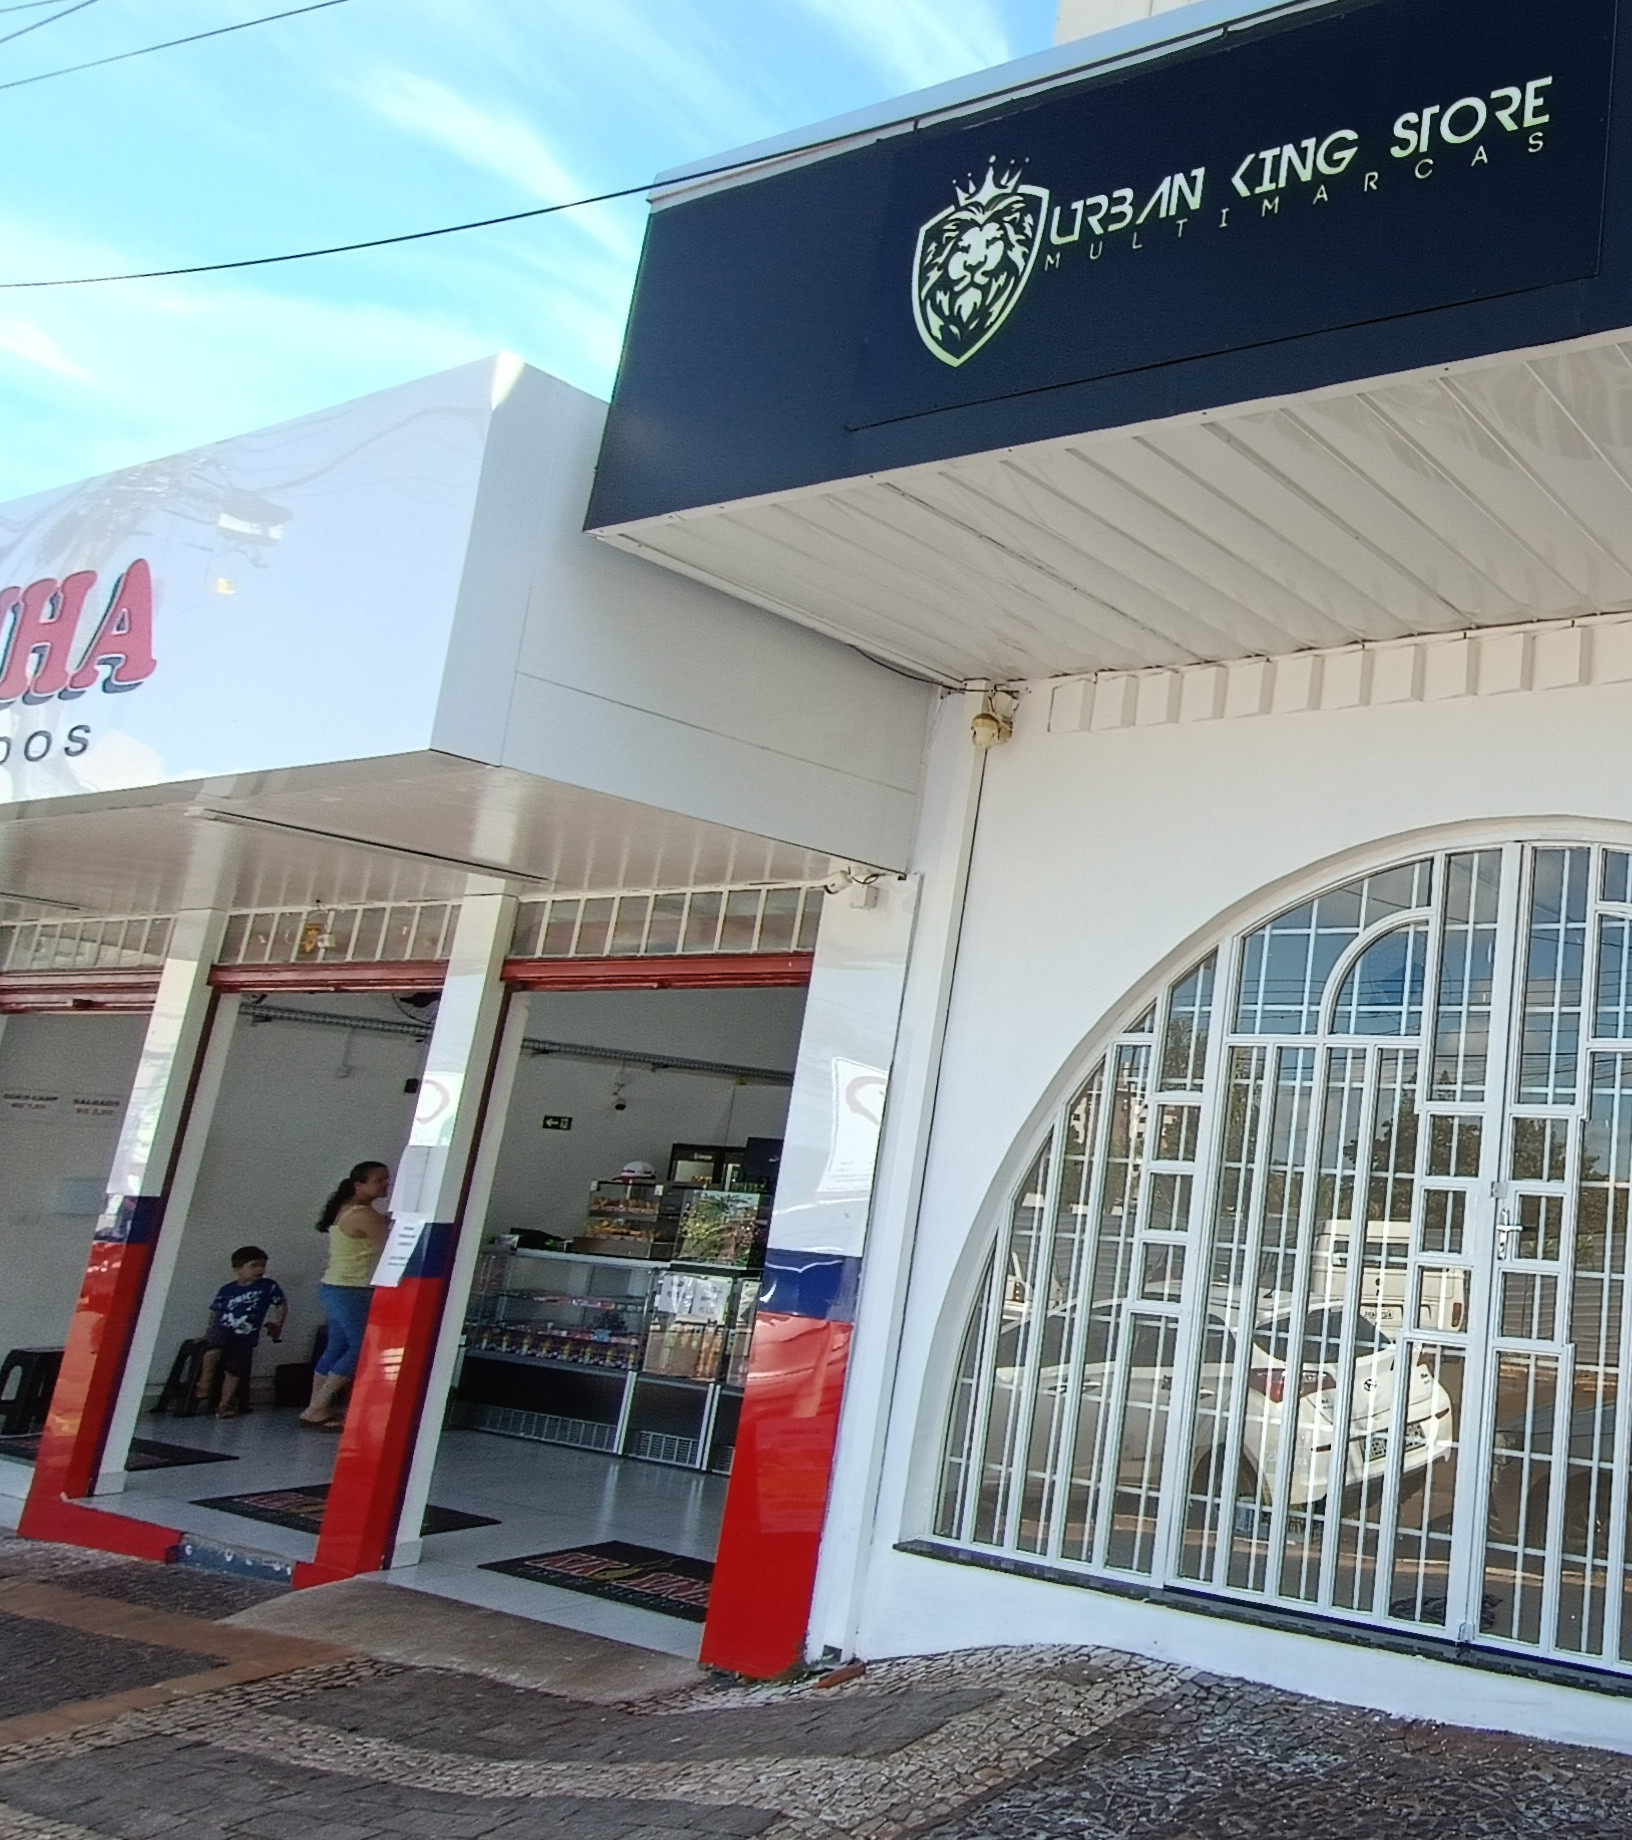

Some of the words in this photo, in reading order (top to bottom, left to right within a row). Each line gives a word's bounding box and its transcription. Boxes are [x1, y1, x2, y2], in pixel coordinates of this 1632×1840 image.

[1044, 131, 1544, 271] MULTIMARCAS
[1050, 167, 1205, 245] URBAN
[1231, 129, 1359, 198] KING
[1390, 75, 1553, 157] STORE
